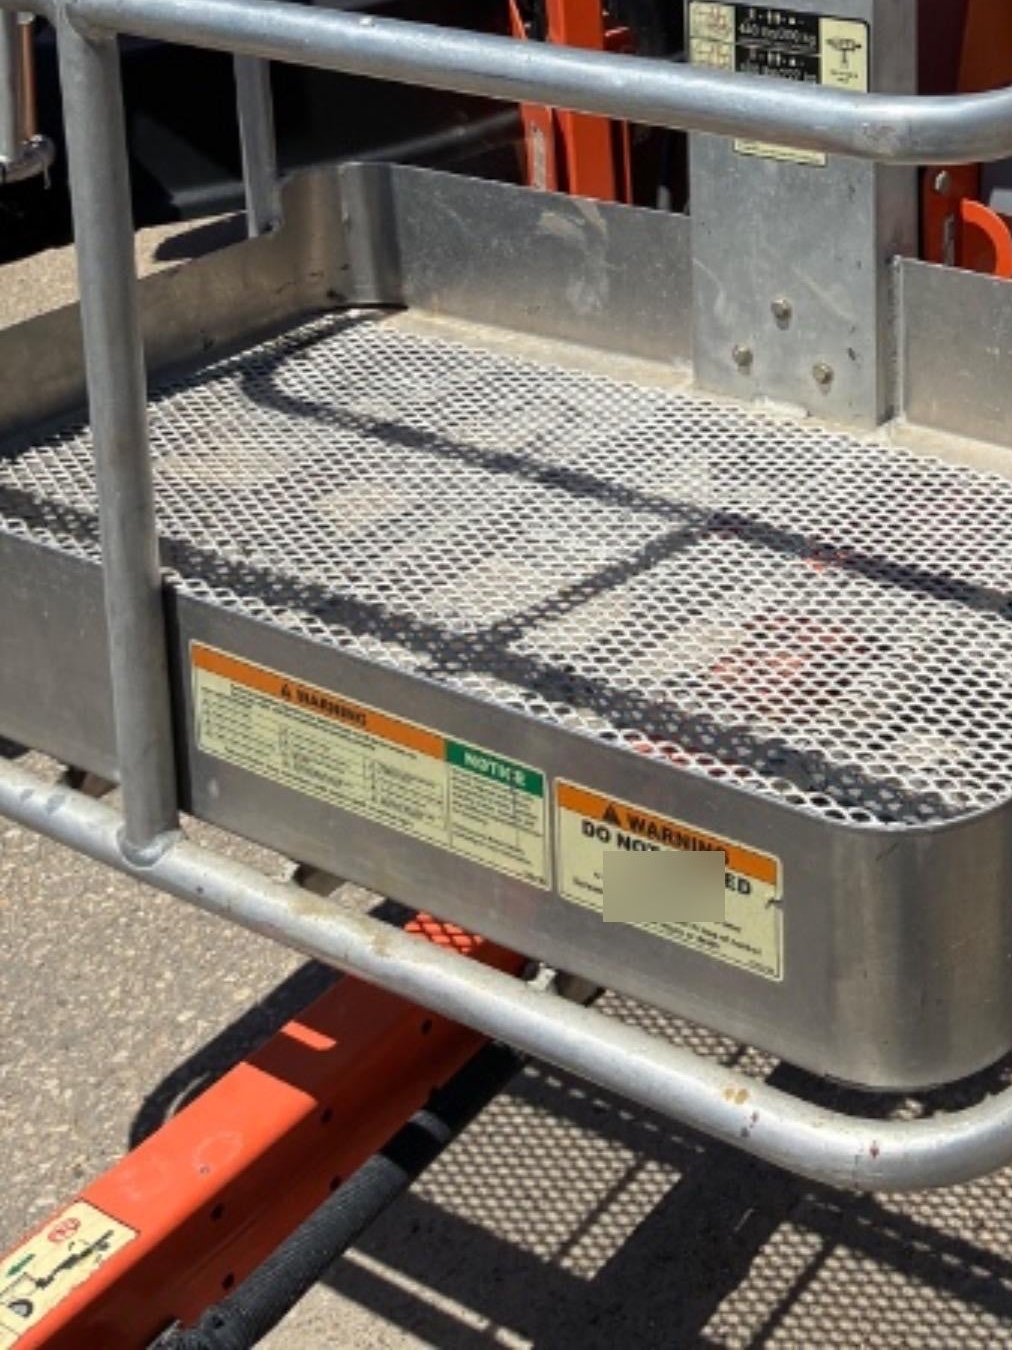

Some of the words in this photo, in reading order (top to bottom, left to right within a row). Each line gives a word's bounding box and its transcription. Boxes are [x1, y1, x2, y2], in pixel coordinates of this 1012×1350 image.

[296, 688, 367, 729] WARNING
[463, 751, 527, 787] NOTICE
[581, 819, 611, 844] DO
